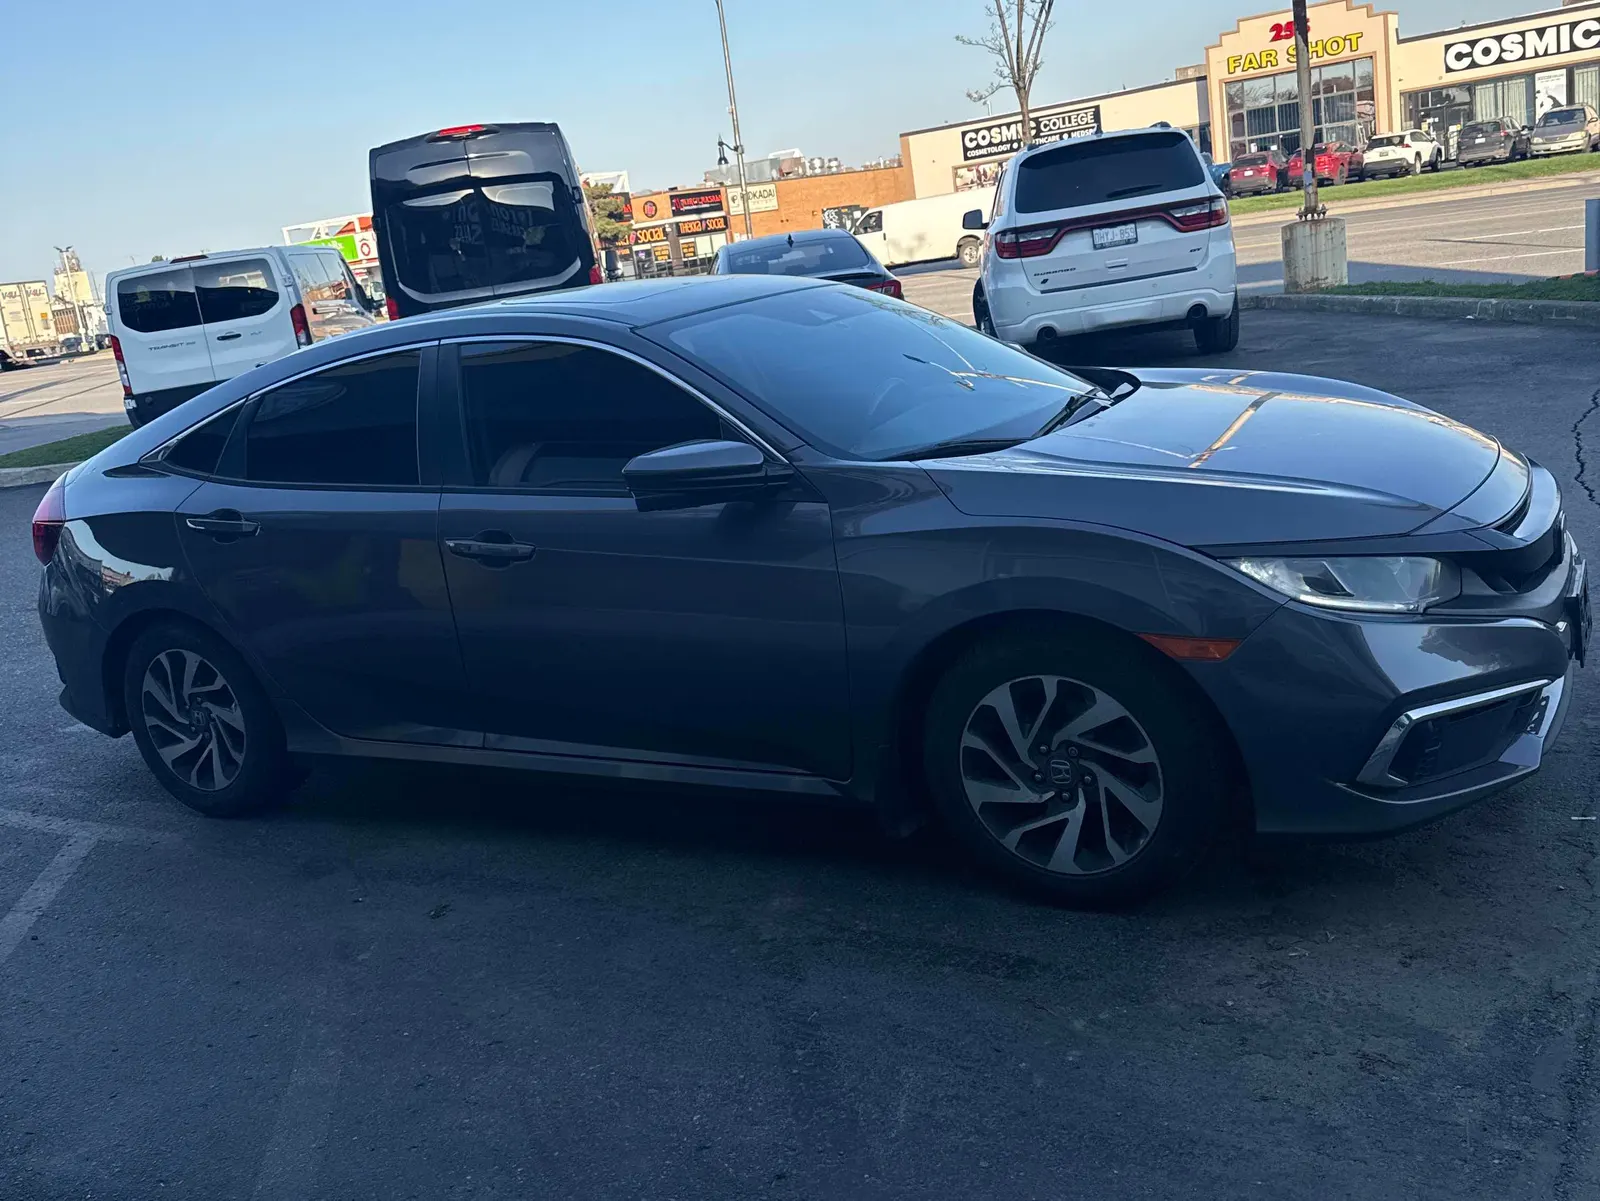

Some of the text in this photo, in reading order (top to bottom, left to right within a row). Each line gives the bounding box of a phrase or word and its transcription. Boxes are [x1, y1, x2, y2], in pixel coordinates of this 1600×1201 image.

[1269, 17, 1311, 42] 25
[1227, 32, 1363, 74] FAR SHOT
[1445, 19, 1600, 70] COSMIC
[1040, 112, 1095, 131] COLLEGE
[966, 143, 1011, 157] COSMETOLOGY
